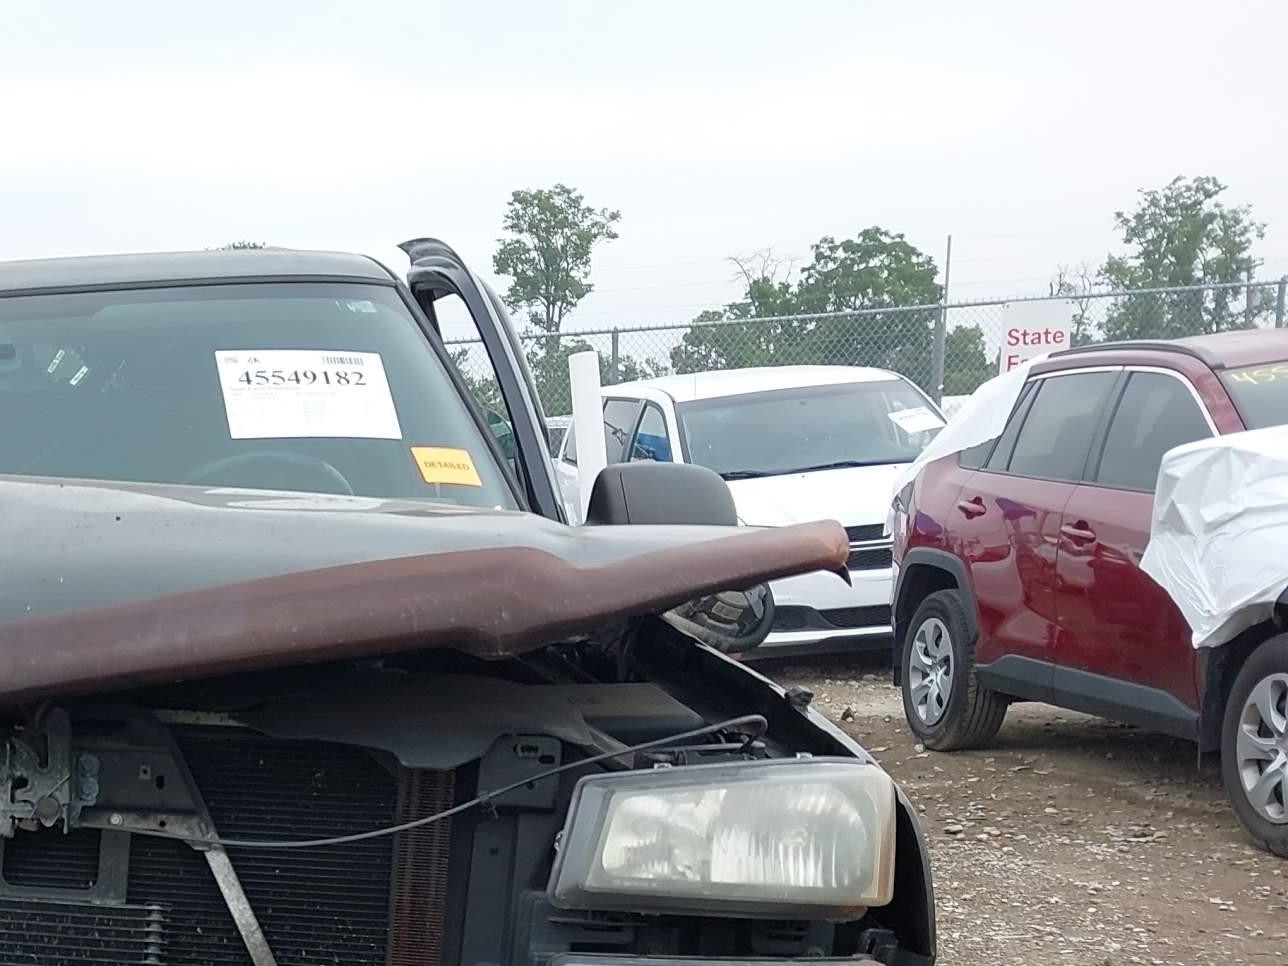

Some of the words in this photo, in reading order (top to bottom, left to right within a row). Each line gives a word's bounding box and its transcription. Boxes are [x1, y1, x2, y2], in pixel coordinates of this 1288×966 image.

[1007, 328, 1065, 346] State
[238, 369, 367, 386] 45549182
[423, 460, 470, 471] DETAILED
